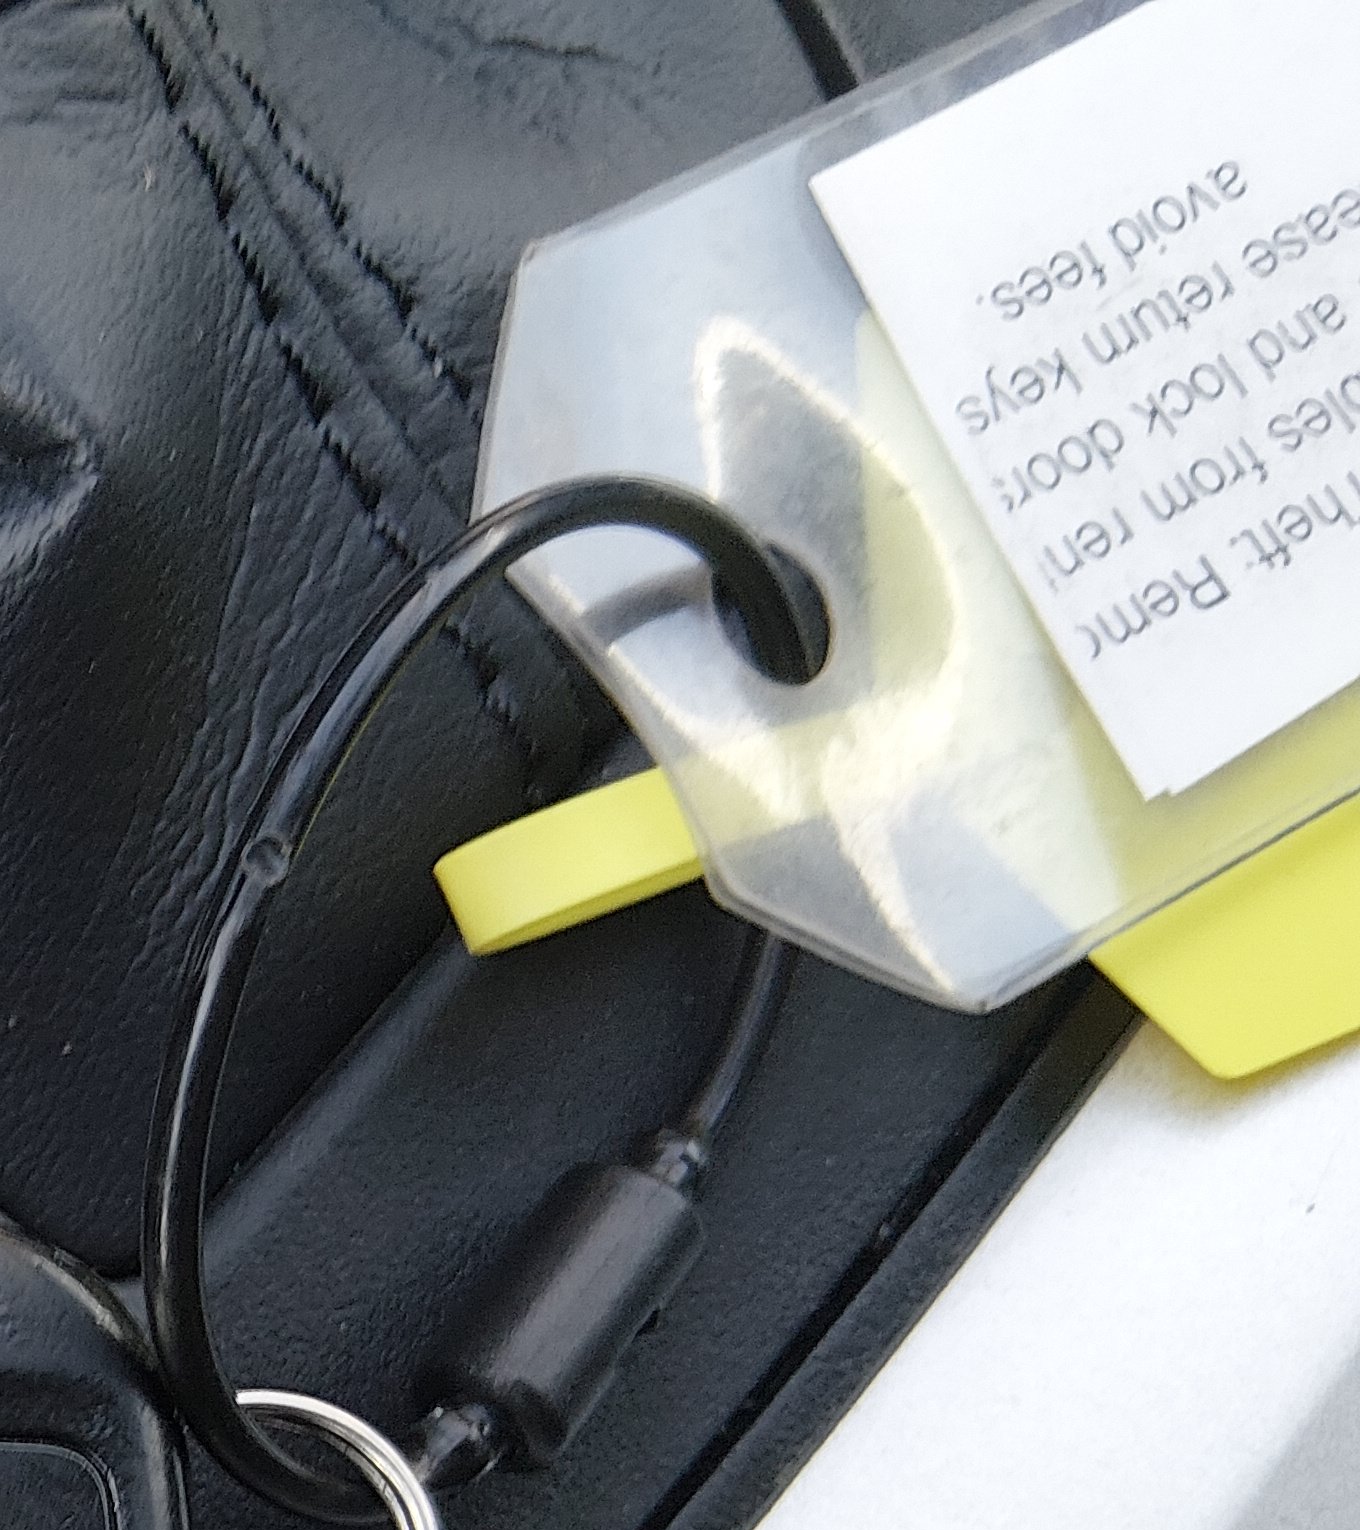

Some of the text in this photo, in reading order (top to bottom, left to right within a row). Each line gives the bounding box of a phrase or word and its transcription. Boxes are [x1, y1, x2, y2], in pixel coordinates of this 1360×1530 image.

[976, 161, 1247, 320] avoid fees.
[1082, 260, 1235, 364] return
[1247, 293, 1347, 382] and
[955, 348, 1083, 436] keys
[1132, 353, 1248, 438] lock
[1140, 436, 1267, 521] from
